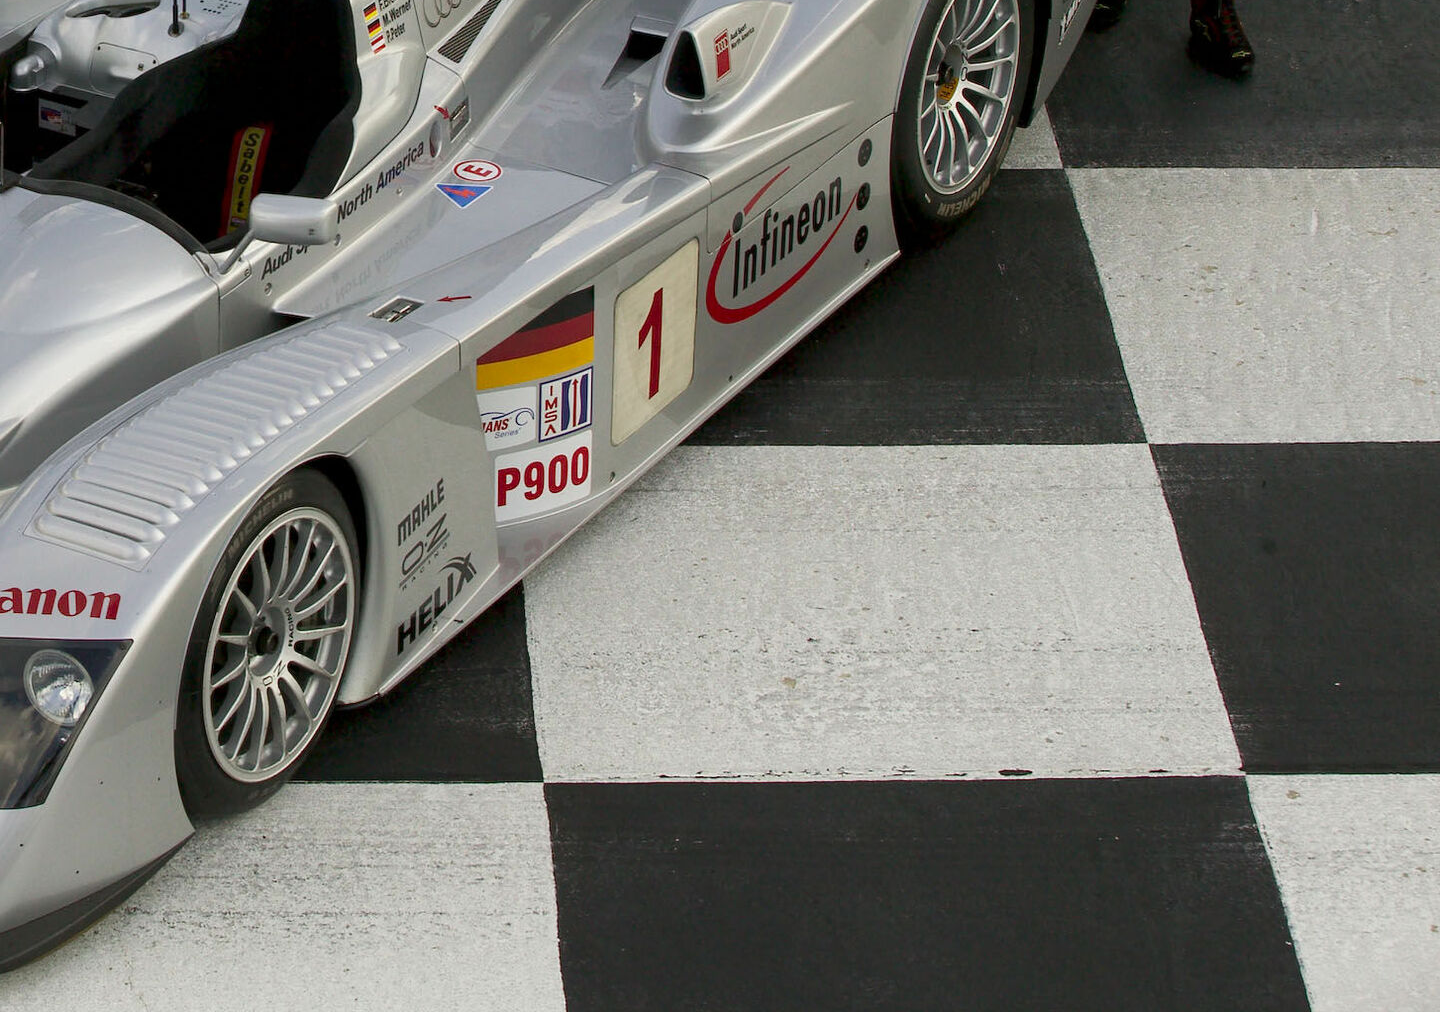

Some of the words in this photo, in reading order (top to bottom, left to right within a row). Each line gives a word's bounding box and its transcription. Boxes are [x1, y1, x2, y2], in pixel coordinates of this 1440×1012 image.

[236, 132, 261, 214] Sabelt
[337, 183, 373, 224] North
[375, 141, 425, 194] America
[462, 164, 493, 178] E
[261, 243, 295, 281] Audi
[732, 175, 842, 300] Infineon
[638, 287, 664, 400] 1
[494, 430, 520, 440] Series
[544, 385, 559, 436] IMSA
[497, 446, 590, 508] P900
[398, 478, 445, 547] MAHLE
[284, 607, 295, 649] RACING
[398, 551, 477, 656] HELIX
